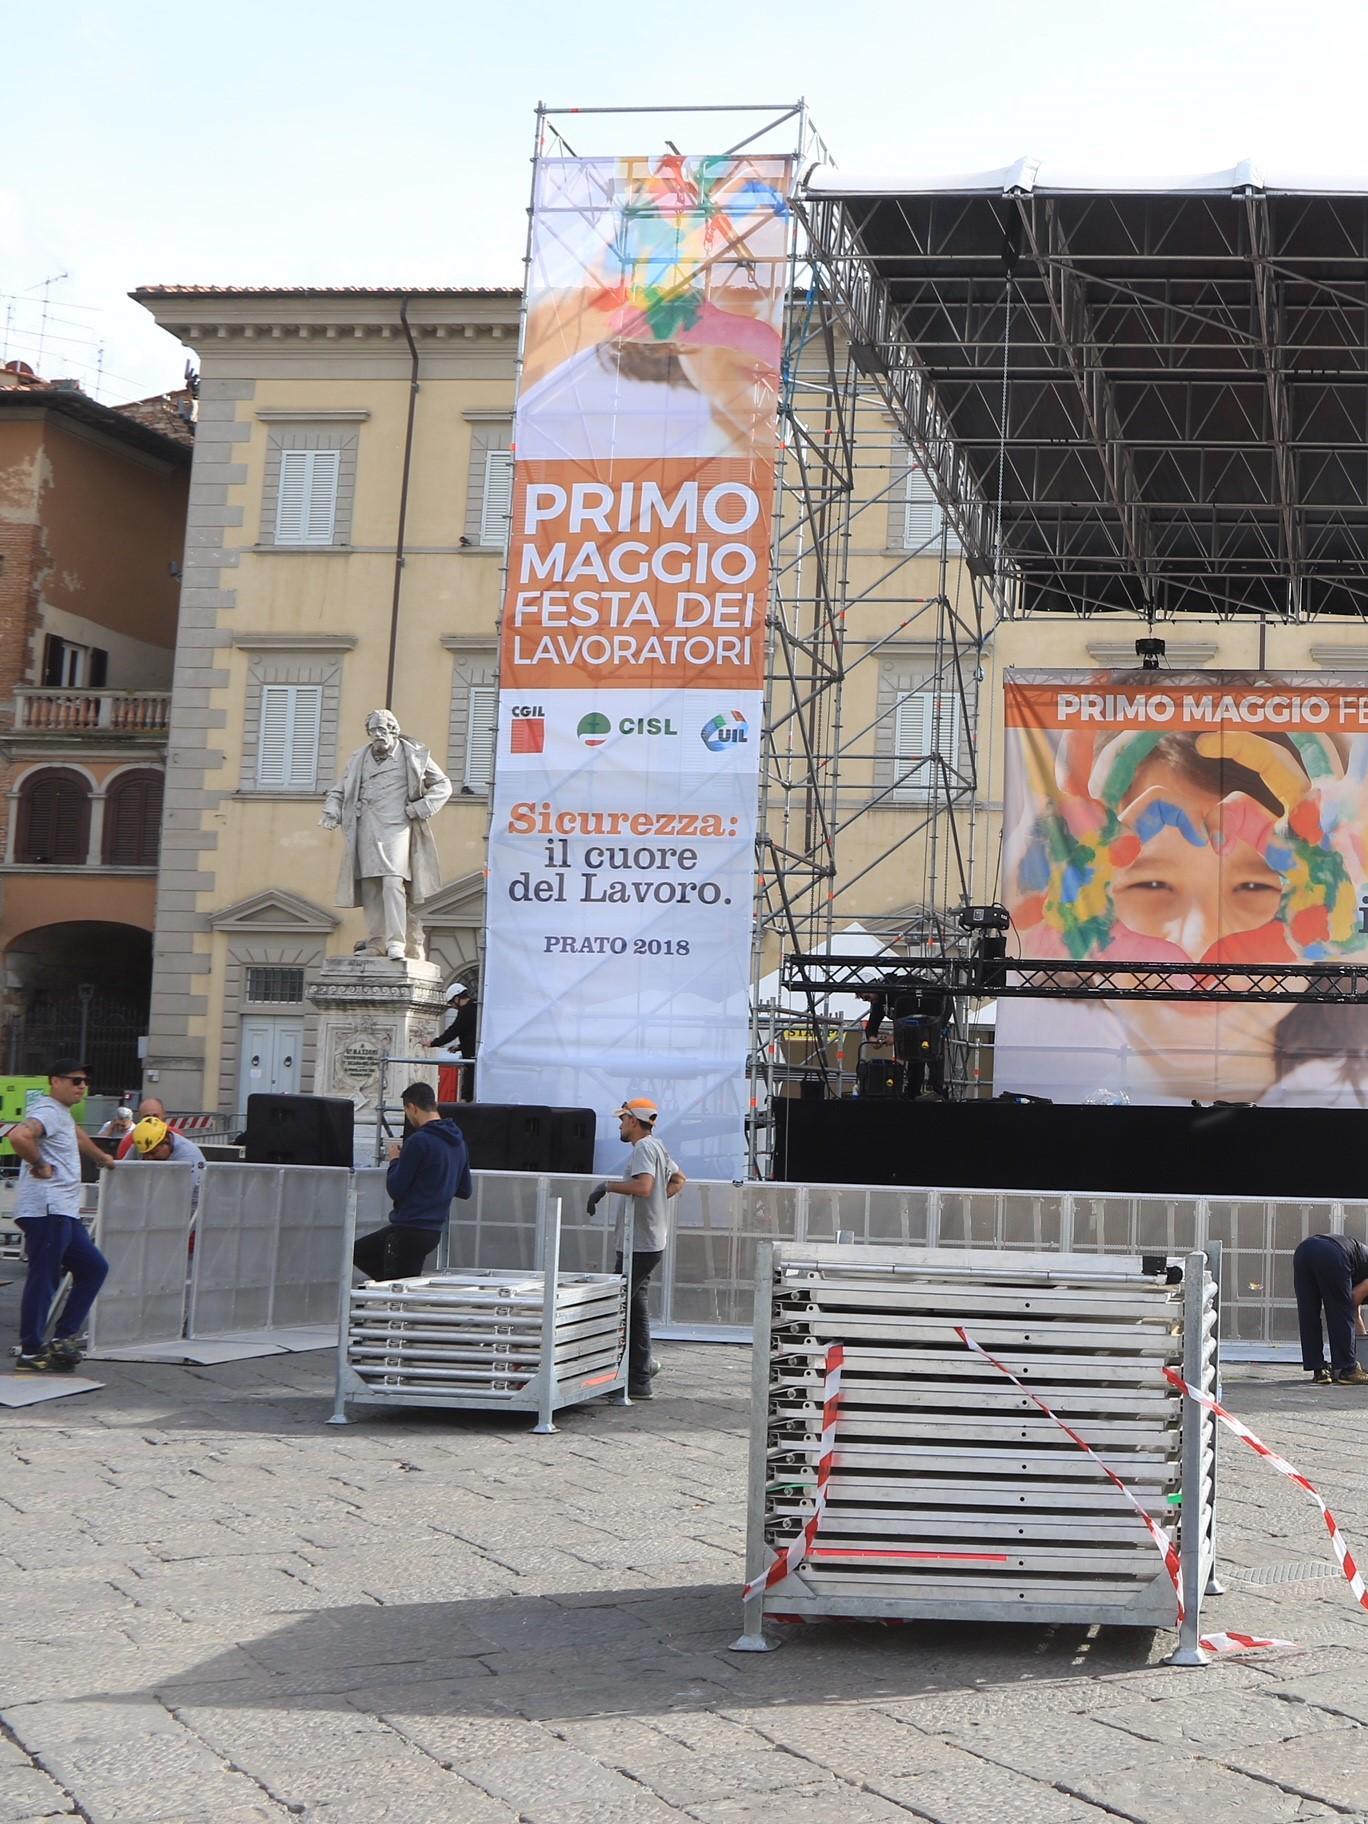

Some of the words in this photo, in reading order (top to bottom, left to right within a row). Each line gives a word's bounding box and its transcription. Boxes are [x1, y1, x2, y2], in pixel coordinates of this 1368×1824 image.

[524, 482, 760, 536] PRIMO
[519, 542, 757, 585] MAGGIO
[514, 591, 660, 628] FESTA
[675, 592, 754, 629] DEI
[513, 634, 751, 666] LAVORATORI
[511, 705, 545, 718] CGIL
[1056, 693, 1175, 722] PRIMO
[1182, 695, 1330, 725] MAGGIO
[618, 716, 678, 736] CISL
[717, 728, 748, 743] UIL
[507, 802, 738, 837] Sicurezza:
[543, 837, 570, 869] il
[584, 844, 698, 871] cuore
[508, 873, 567, 904] del
[580, 874, 732, 906] Lavoro.
[543, 936, 628, 955] PRATO
[634, 937, 690, 956] 2018
